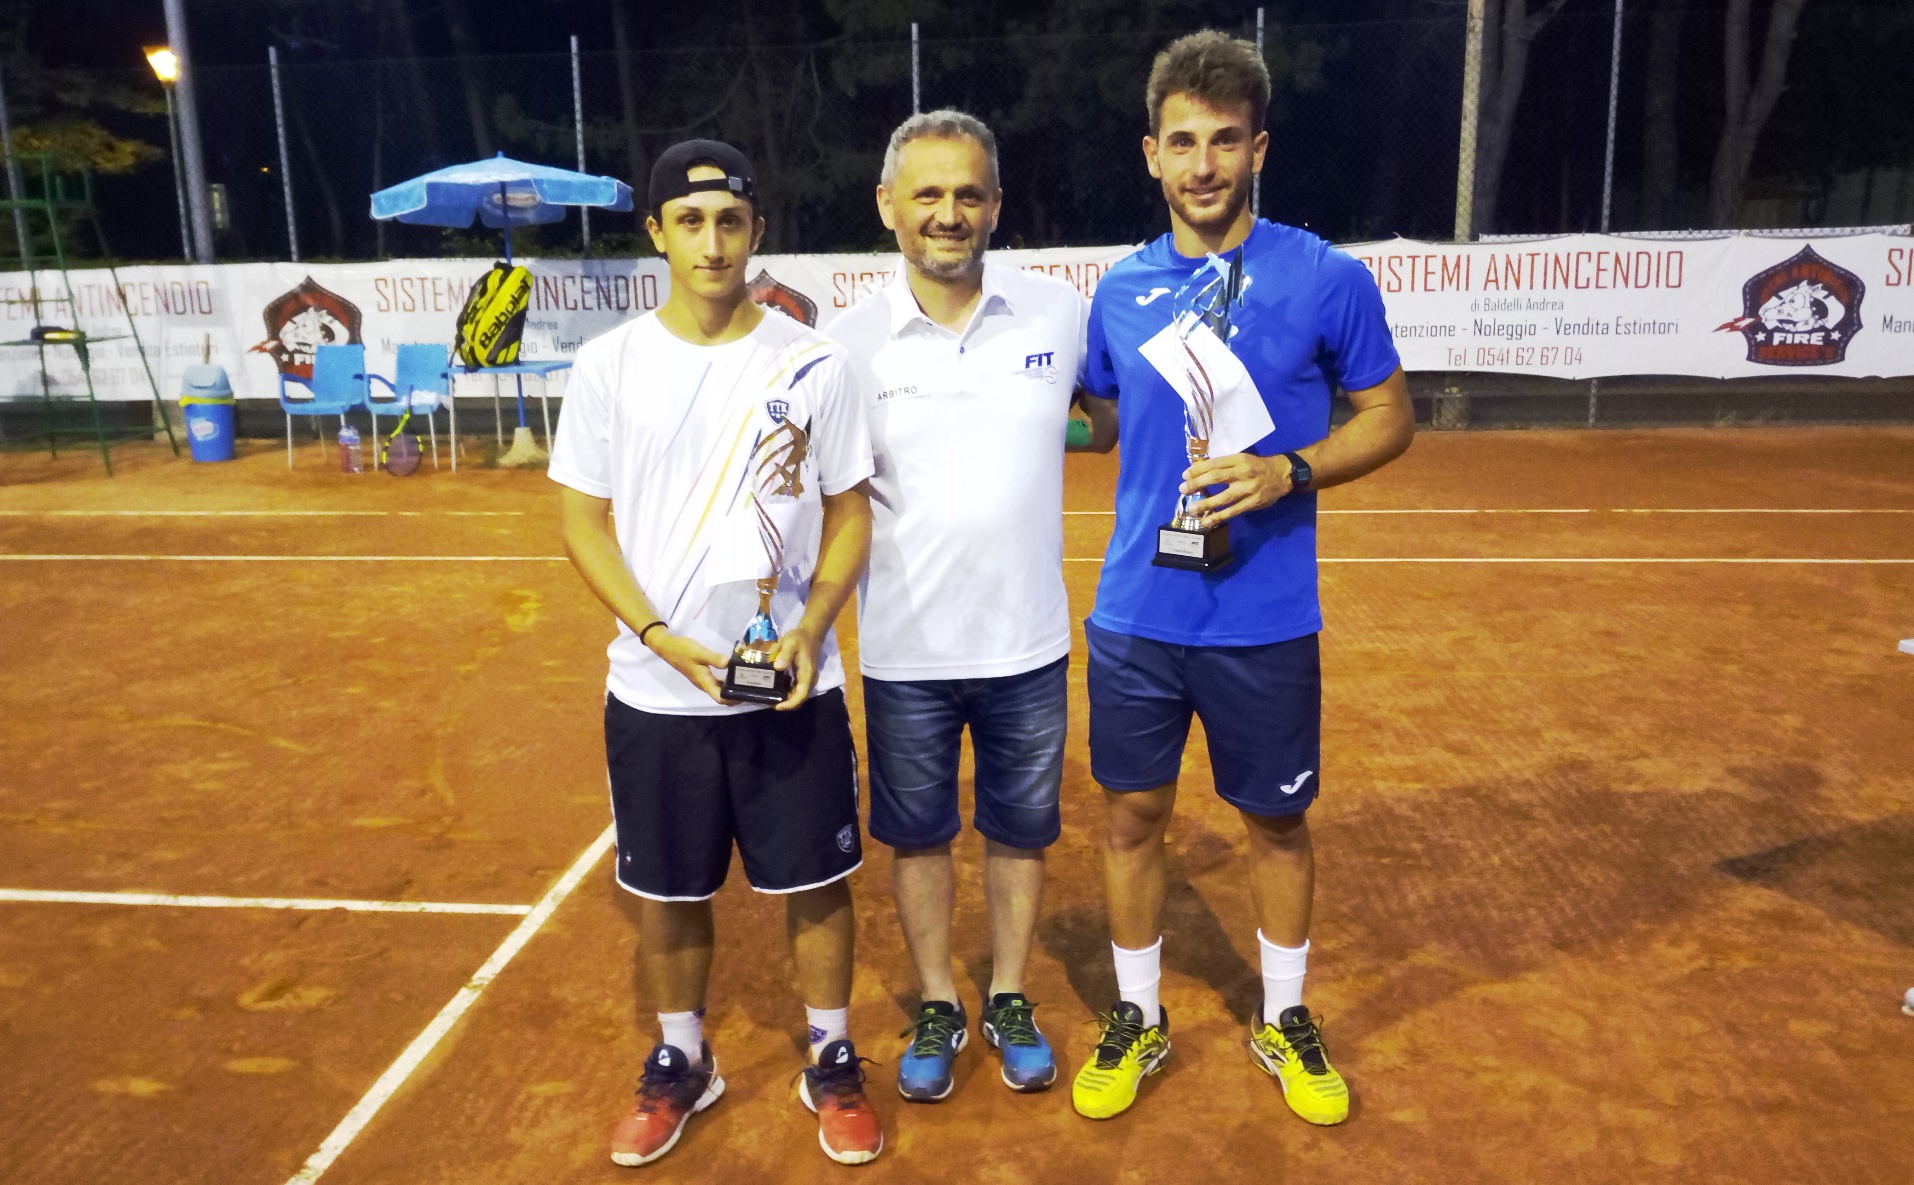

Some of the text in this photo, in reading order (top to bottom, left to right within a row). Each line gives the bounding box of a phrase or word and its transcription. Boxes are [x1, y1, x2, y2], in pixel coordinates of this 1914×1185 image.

[1484, 251, 1683, 290] ANTINCENDIO
[479, 275, 531, 350] Babolat
[1470, 297, 1564, 312] di Baldelli Andrea
[1473, 318, 1537, 340] Noleggio
[1554, 317, 1609, 336] Vendita
[1615, 315, 1679, 335] Estintori
[1772, 331, 1826, 346] FIRE
[1025, 351, 1054, 369] FIT
[1476, 347, 1510, 366] 0541
[1515, 347, 1535, 366] 62
[1540, 346, 1559, 366] 67
[1564, 346, 1583, 366] 04
[877, 385, 918, 402] ARBITRO
